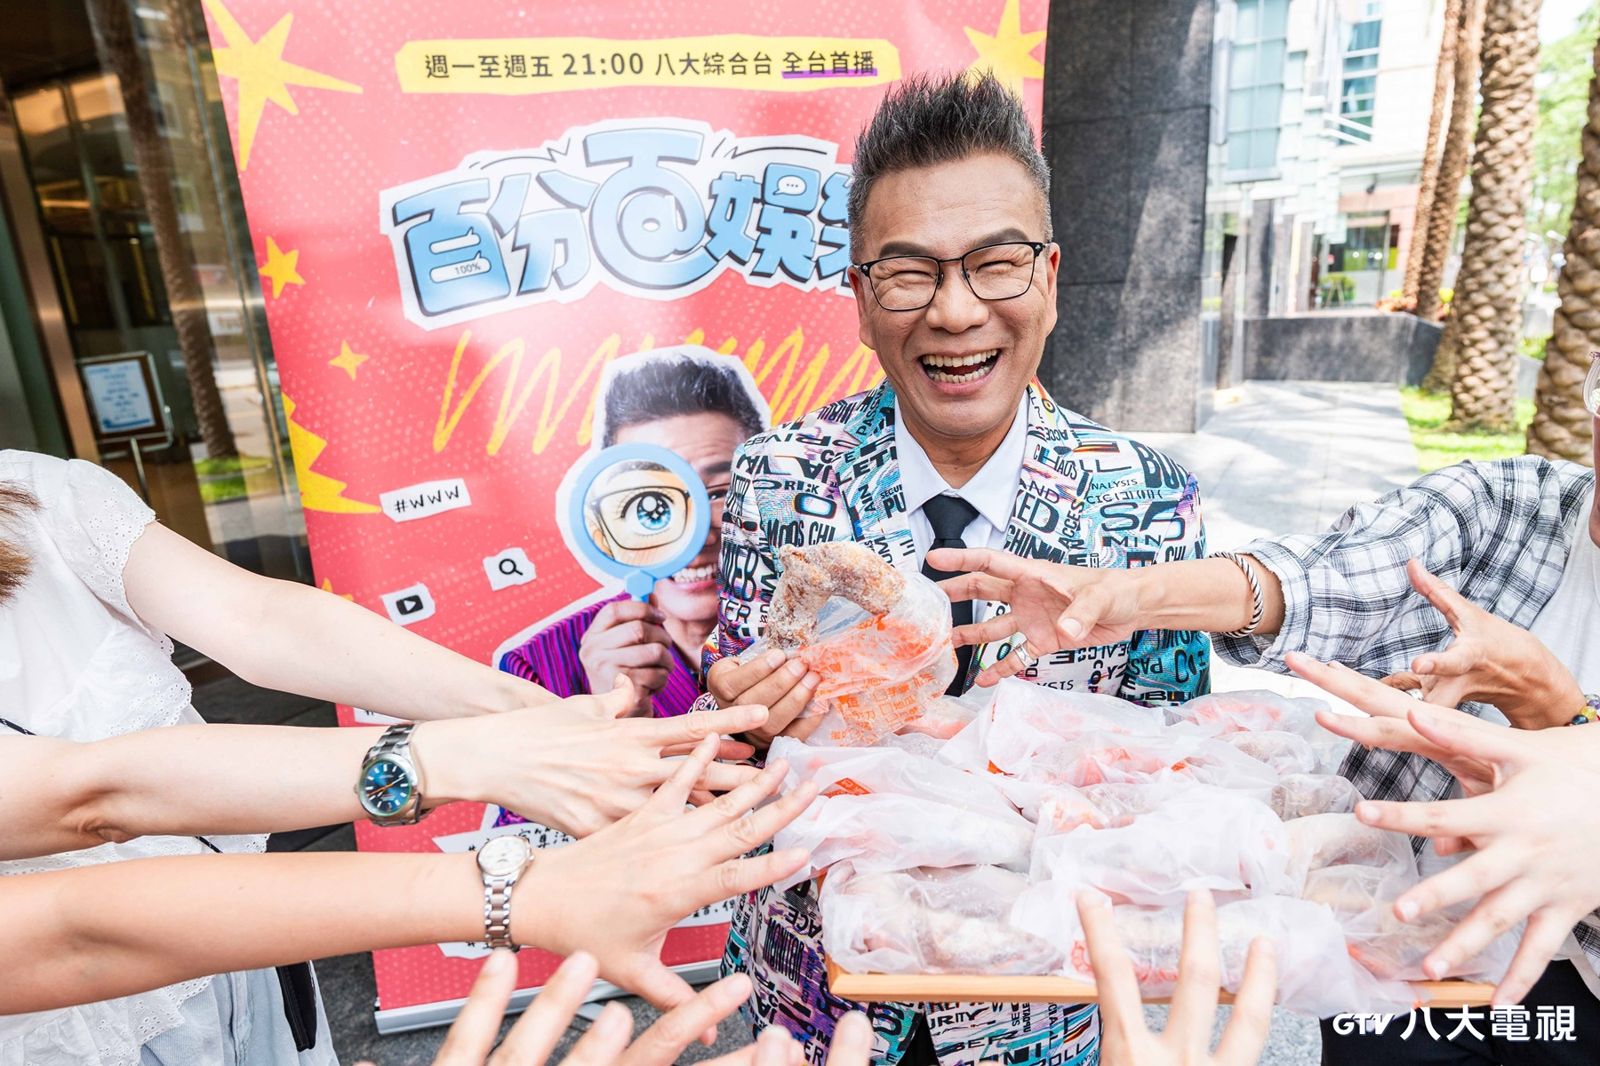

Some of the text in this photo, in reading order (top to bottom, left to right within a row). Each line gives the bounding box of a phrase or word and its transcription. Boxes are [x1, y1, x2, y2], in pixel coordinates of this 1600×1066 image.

[424, 50, 875, 79] 週一至週五 21:00 八大綜合台 全台首播
[454, 263, 481, 276] 100%
